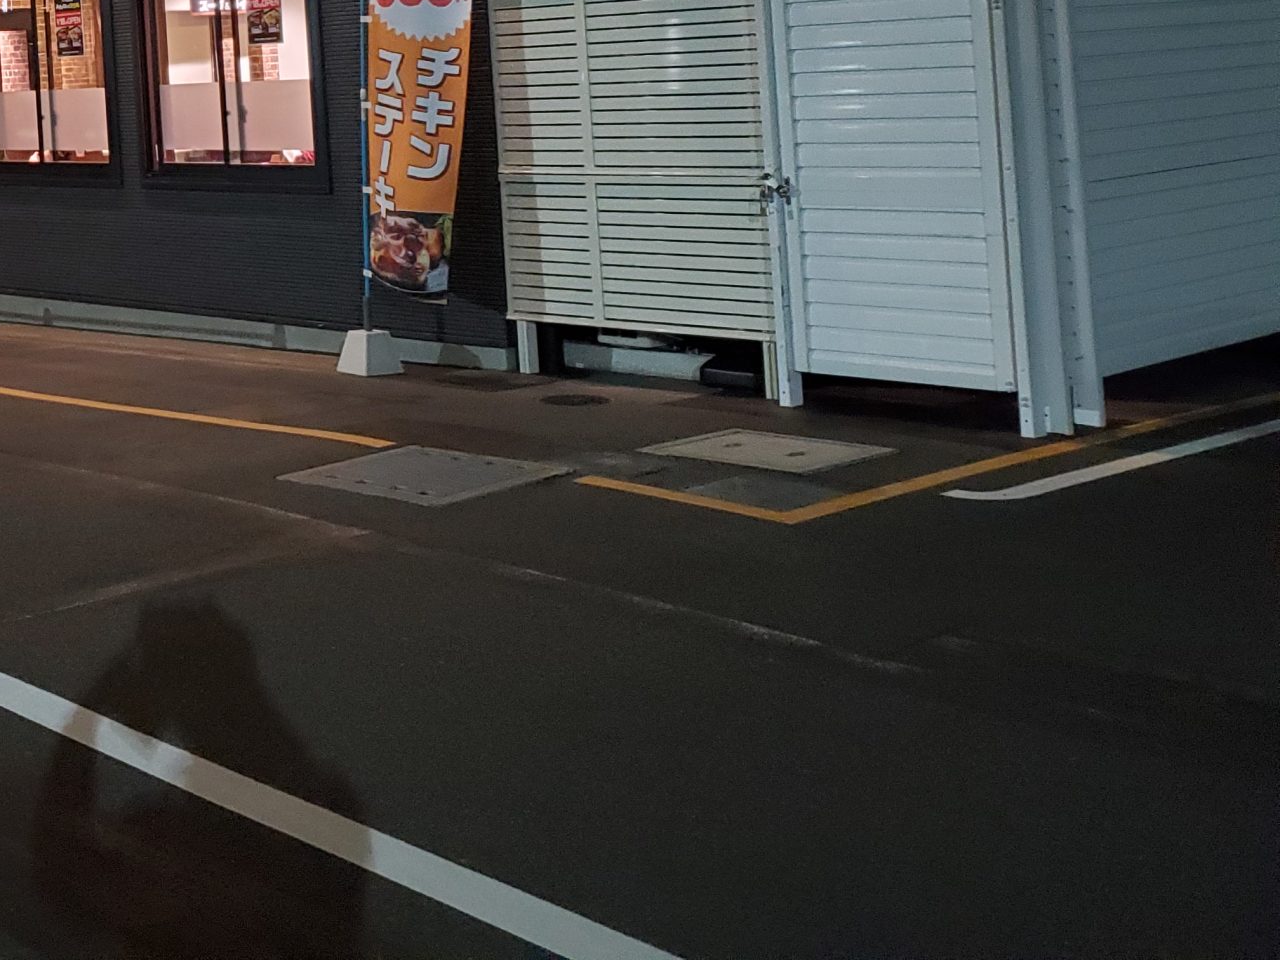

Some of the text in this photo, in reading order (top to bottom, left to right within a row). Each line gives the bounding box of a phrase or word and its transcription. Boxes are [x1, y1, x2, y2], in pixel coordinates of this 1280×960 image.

[371, 49, 404, 219] ステーキ
[407, 48, 461, 180] チキン
